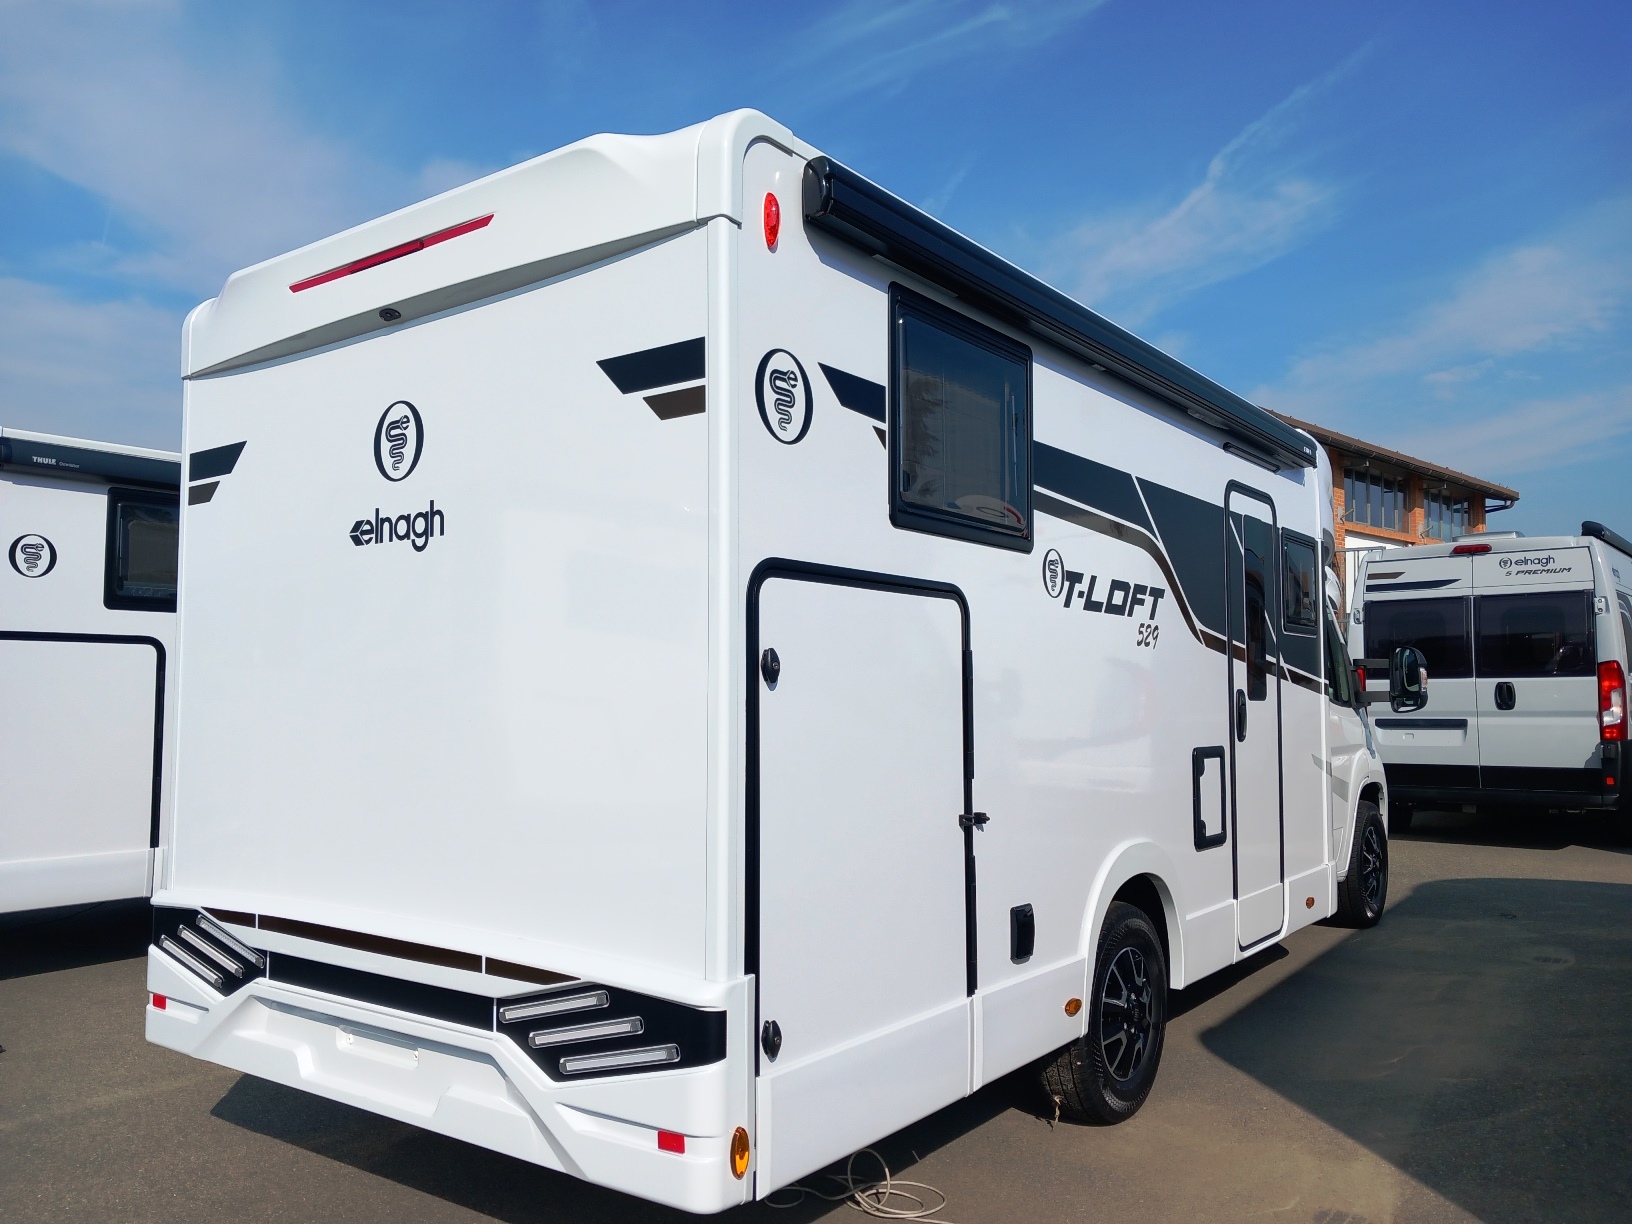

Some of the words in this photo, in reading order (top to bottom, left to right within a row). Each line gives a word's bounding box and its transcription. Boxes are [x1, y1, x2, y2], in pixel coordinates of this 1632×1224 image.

[32, 456, 57, 466] THULE
[349, 499, 445, 553] elnagh
[1513, 555, 1556, 568] elnagh
[1515, 567, 1572, 576] PREMIUM
[1063, 570, 1165, 621] T-LOFT
[1136, 623, 1160, 650] 529
